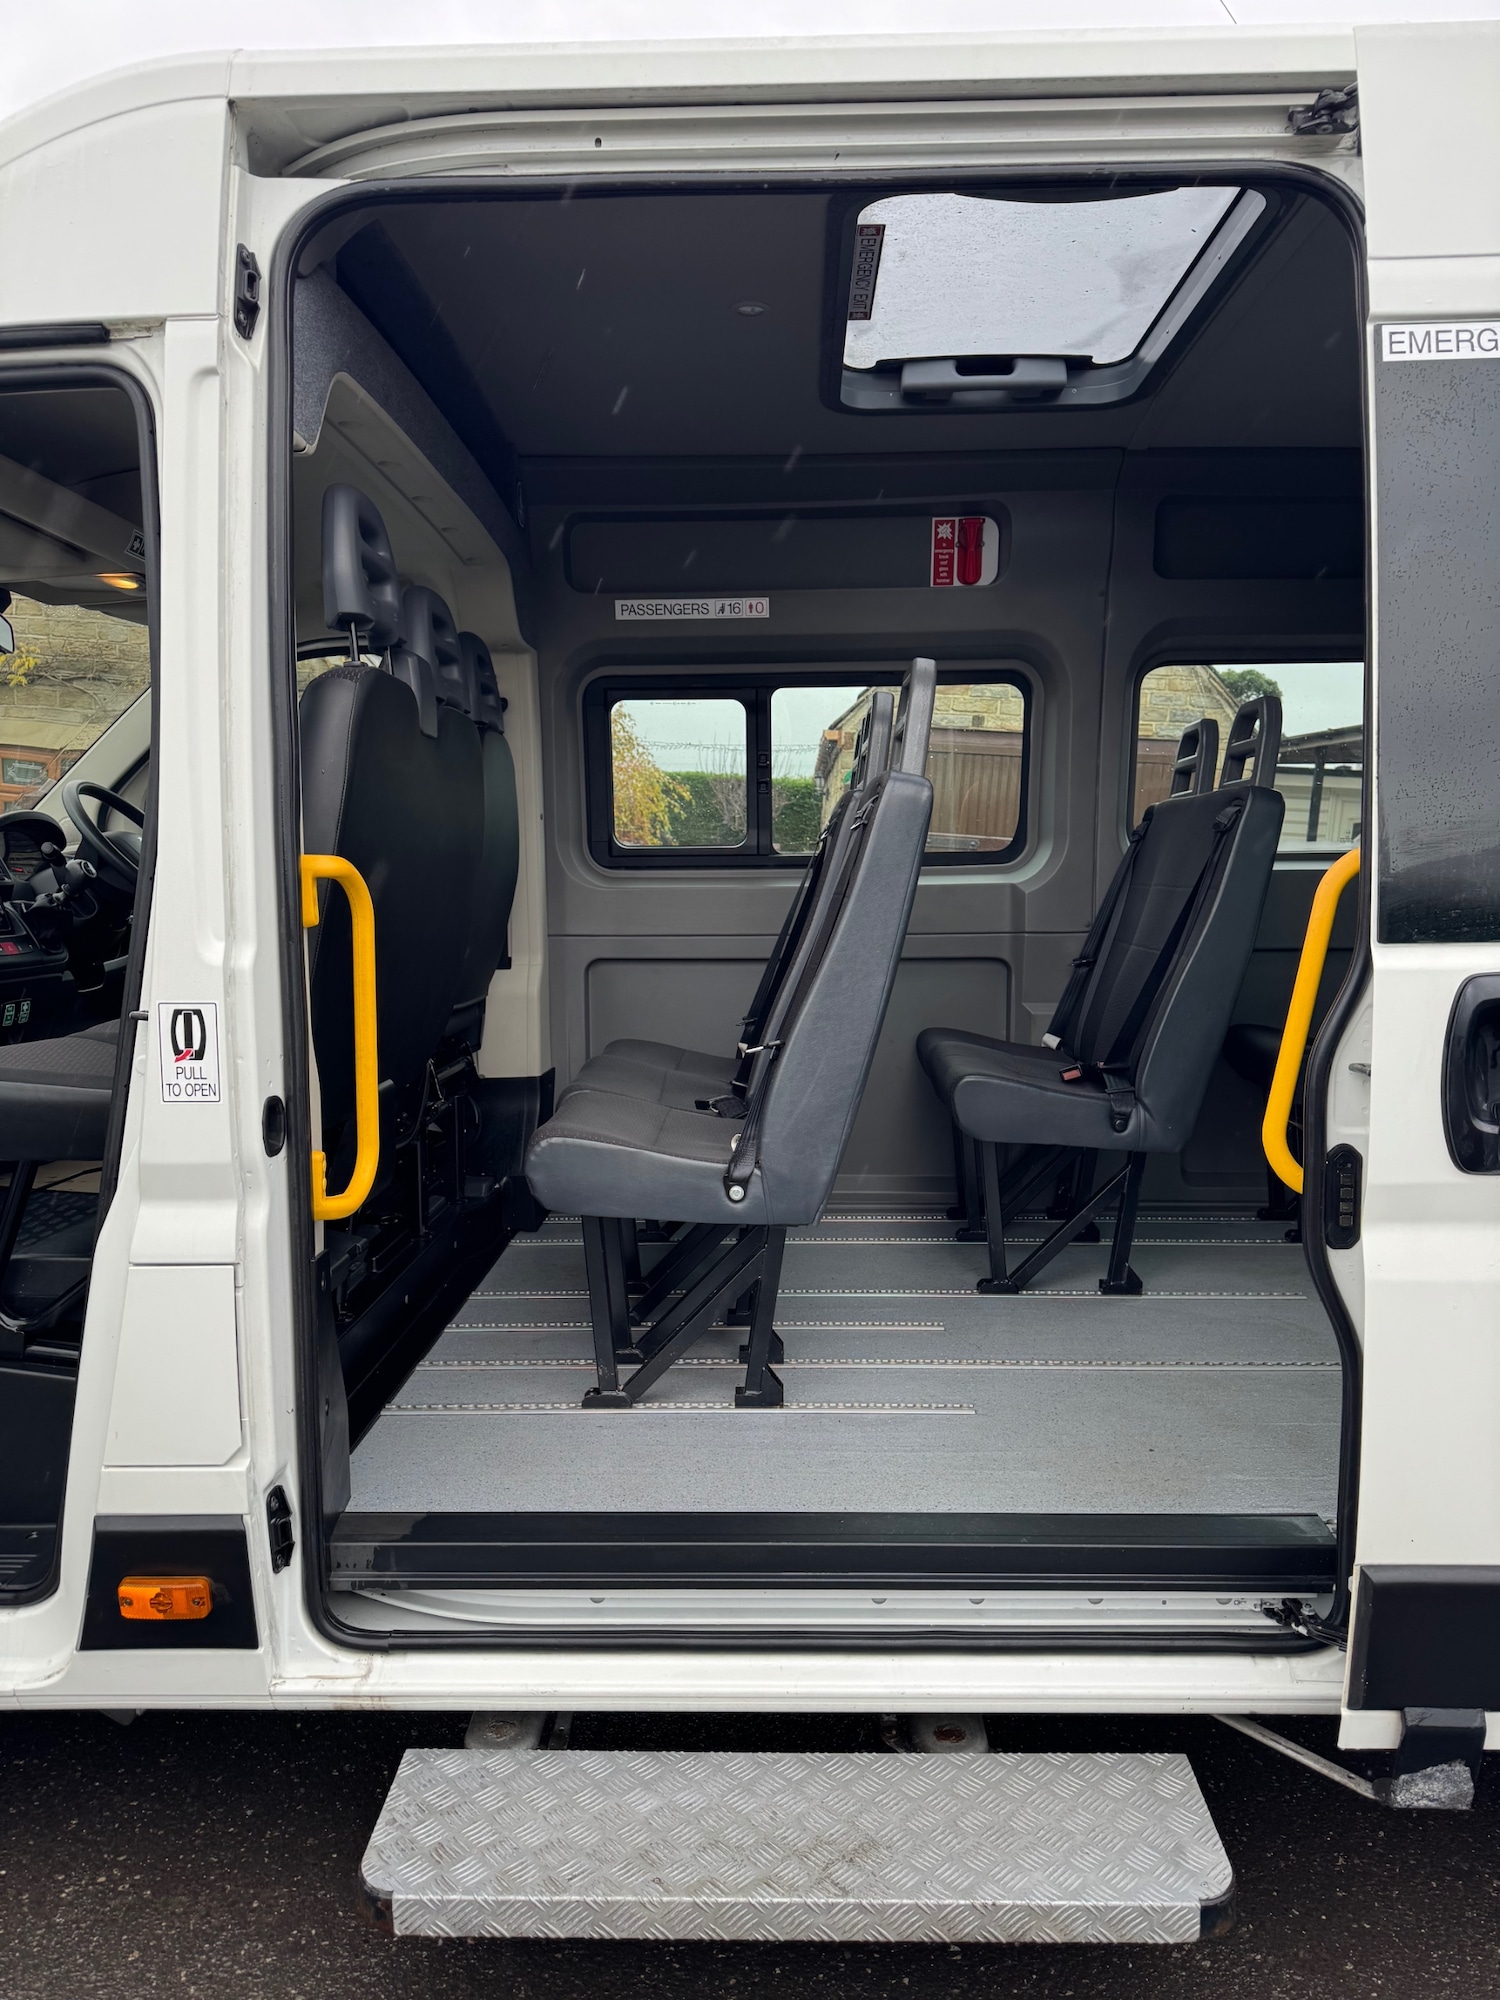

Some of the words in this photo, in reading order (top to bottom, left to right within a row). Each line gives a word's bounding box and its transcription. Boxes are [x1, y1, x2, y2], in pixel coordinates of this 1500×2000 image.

[855, 238, 876, 291] EMERGENCY
[853, 294, 868, 310] EXIT
[1389, 328, 1499, 354] EMERG
[621, 603, 709, 616] PASSENGERS
[727, 602, 741, 615] 16
[176, 1066, 207, 1080] PULL
[166, 1083, 181, 1097] TO
[185, 1083, 217, 1097] OPEN
